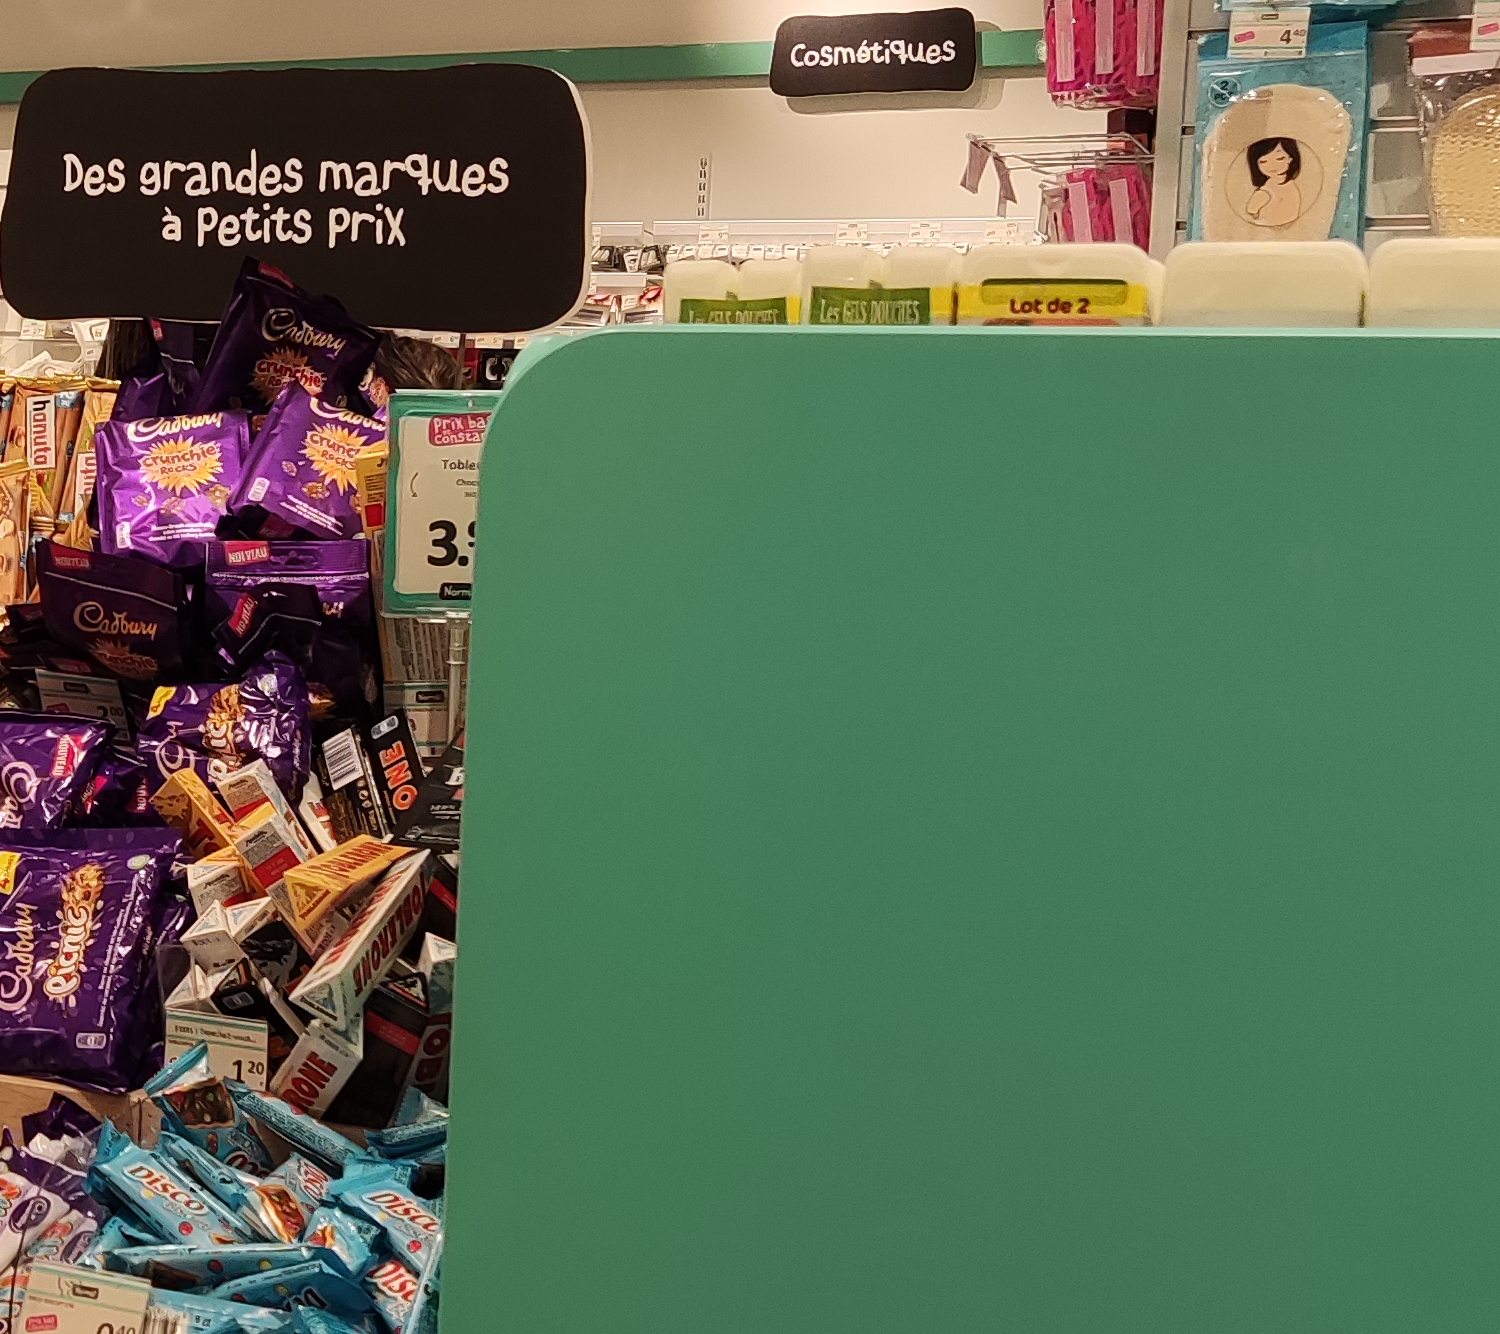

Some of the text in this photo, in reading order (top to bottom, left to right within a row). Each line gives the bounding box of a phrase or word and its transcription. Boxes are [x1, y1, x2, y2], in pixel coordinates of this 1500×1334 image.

[789, 40, 957, 69] Cosmétiques
[62, 148, 510, 198] Des grandes marques
[161, 205, 182, 243] à
[1010, 297, 1091, 315] Lot de 2
[261, 308, 347, 354] Cadbury
[33, 399, 52, 466] hanuta
[73, 601, 158, 641] Cadbury
[43, 903, 90, 999] Picnic
